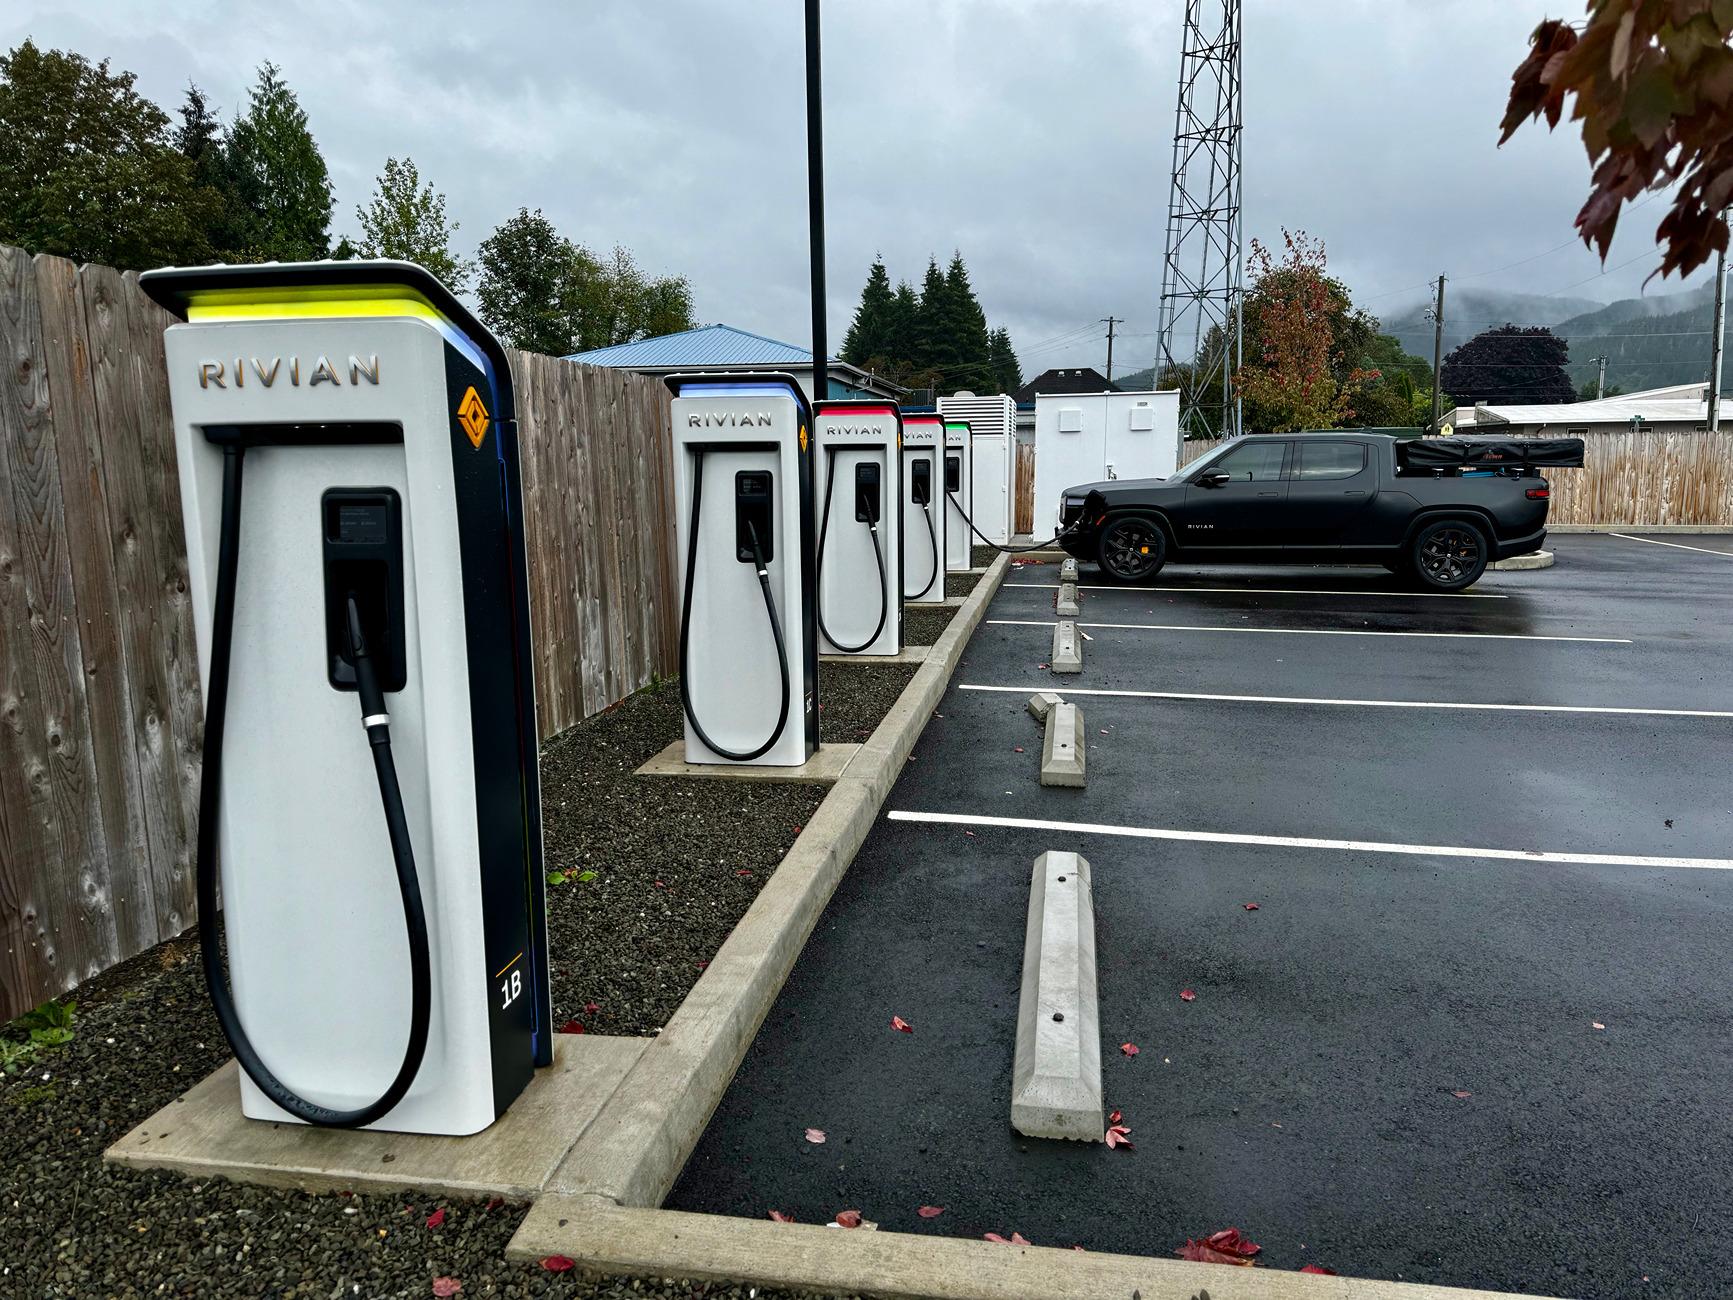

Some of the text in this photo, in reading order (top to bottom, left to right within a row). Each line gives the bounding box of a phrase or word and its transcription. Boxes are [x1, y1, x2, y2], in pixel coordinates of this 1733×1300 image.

[198, 355, 380, 389] RIVIAN
[688, 412, 771, 427] RIVIAN
[827, 425, 881, 435] RIVIAN
[904, 431, 932, 439] VIAN
[501, 970, 521, 1010] 1B
